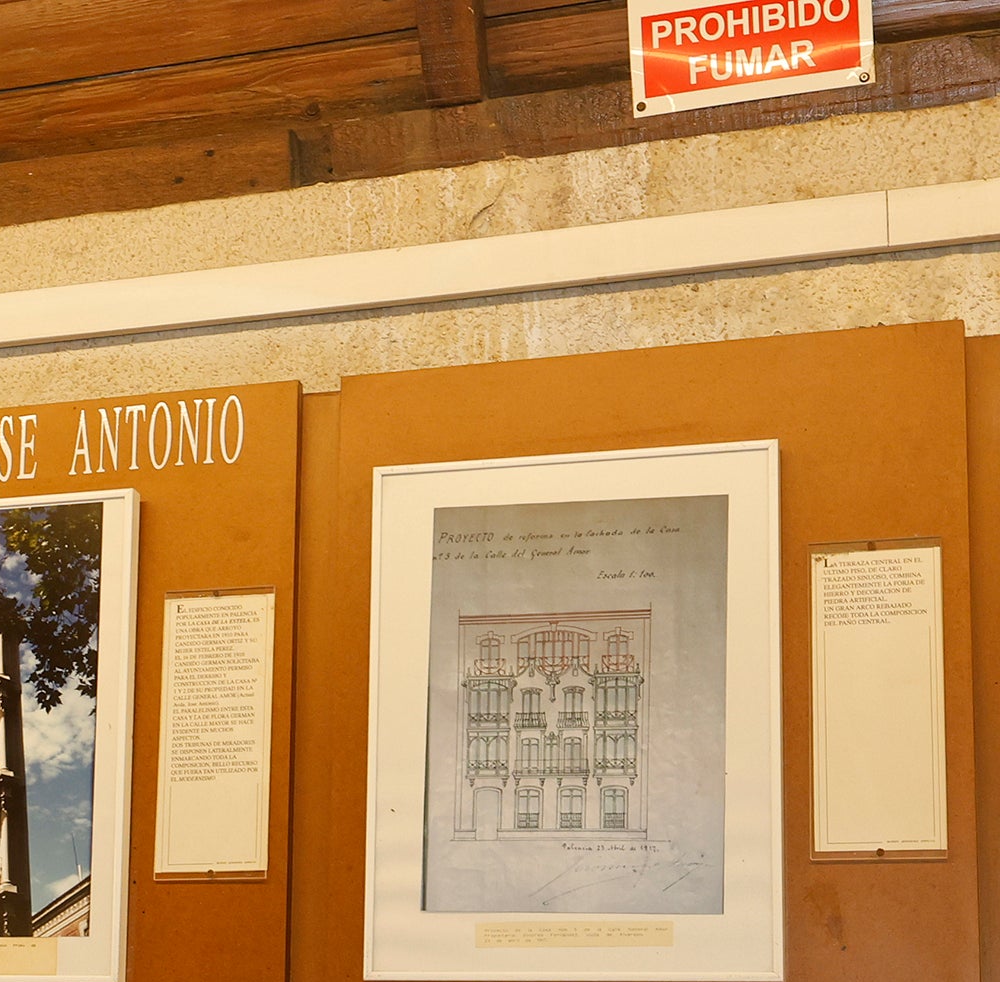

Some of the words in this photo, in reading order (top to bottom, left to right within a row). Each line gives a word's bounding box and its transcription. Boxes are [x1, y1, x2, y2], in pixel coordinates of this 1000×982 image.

[651, 0, 850, 49] PROHIBIDO
[688, 39, 816, 85] FUMAR
[68, 394, 244, 477] ANTONIO
[438, 531, 495, 544] PROYECTO
[824, 581, 882, 590] ELEGANTEMENTE
